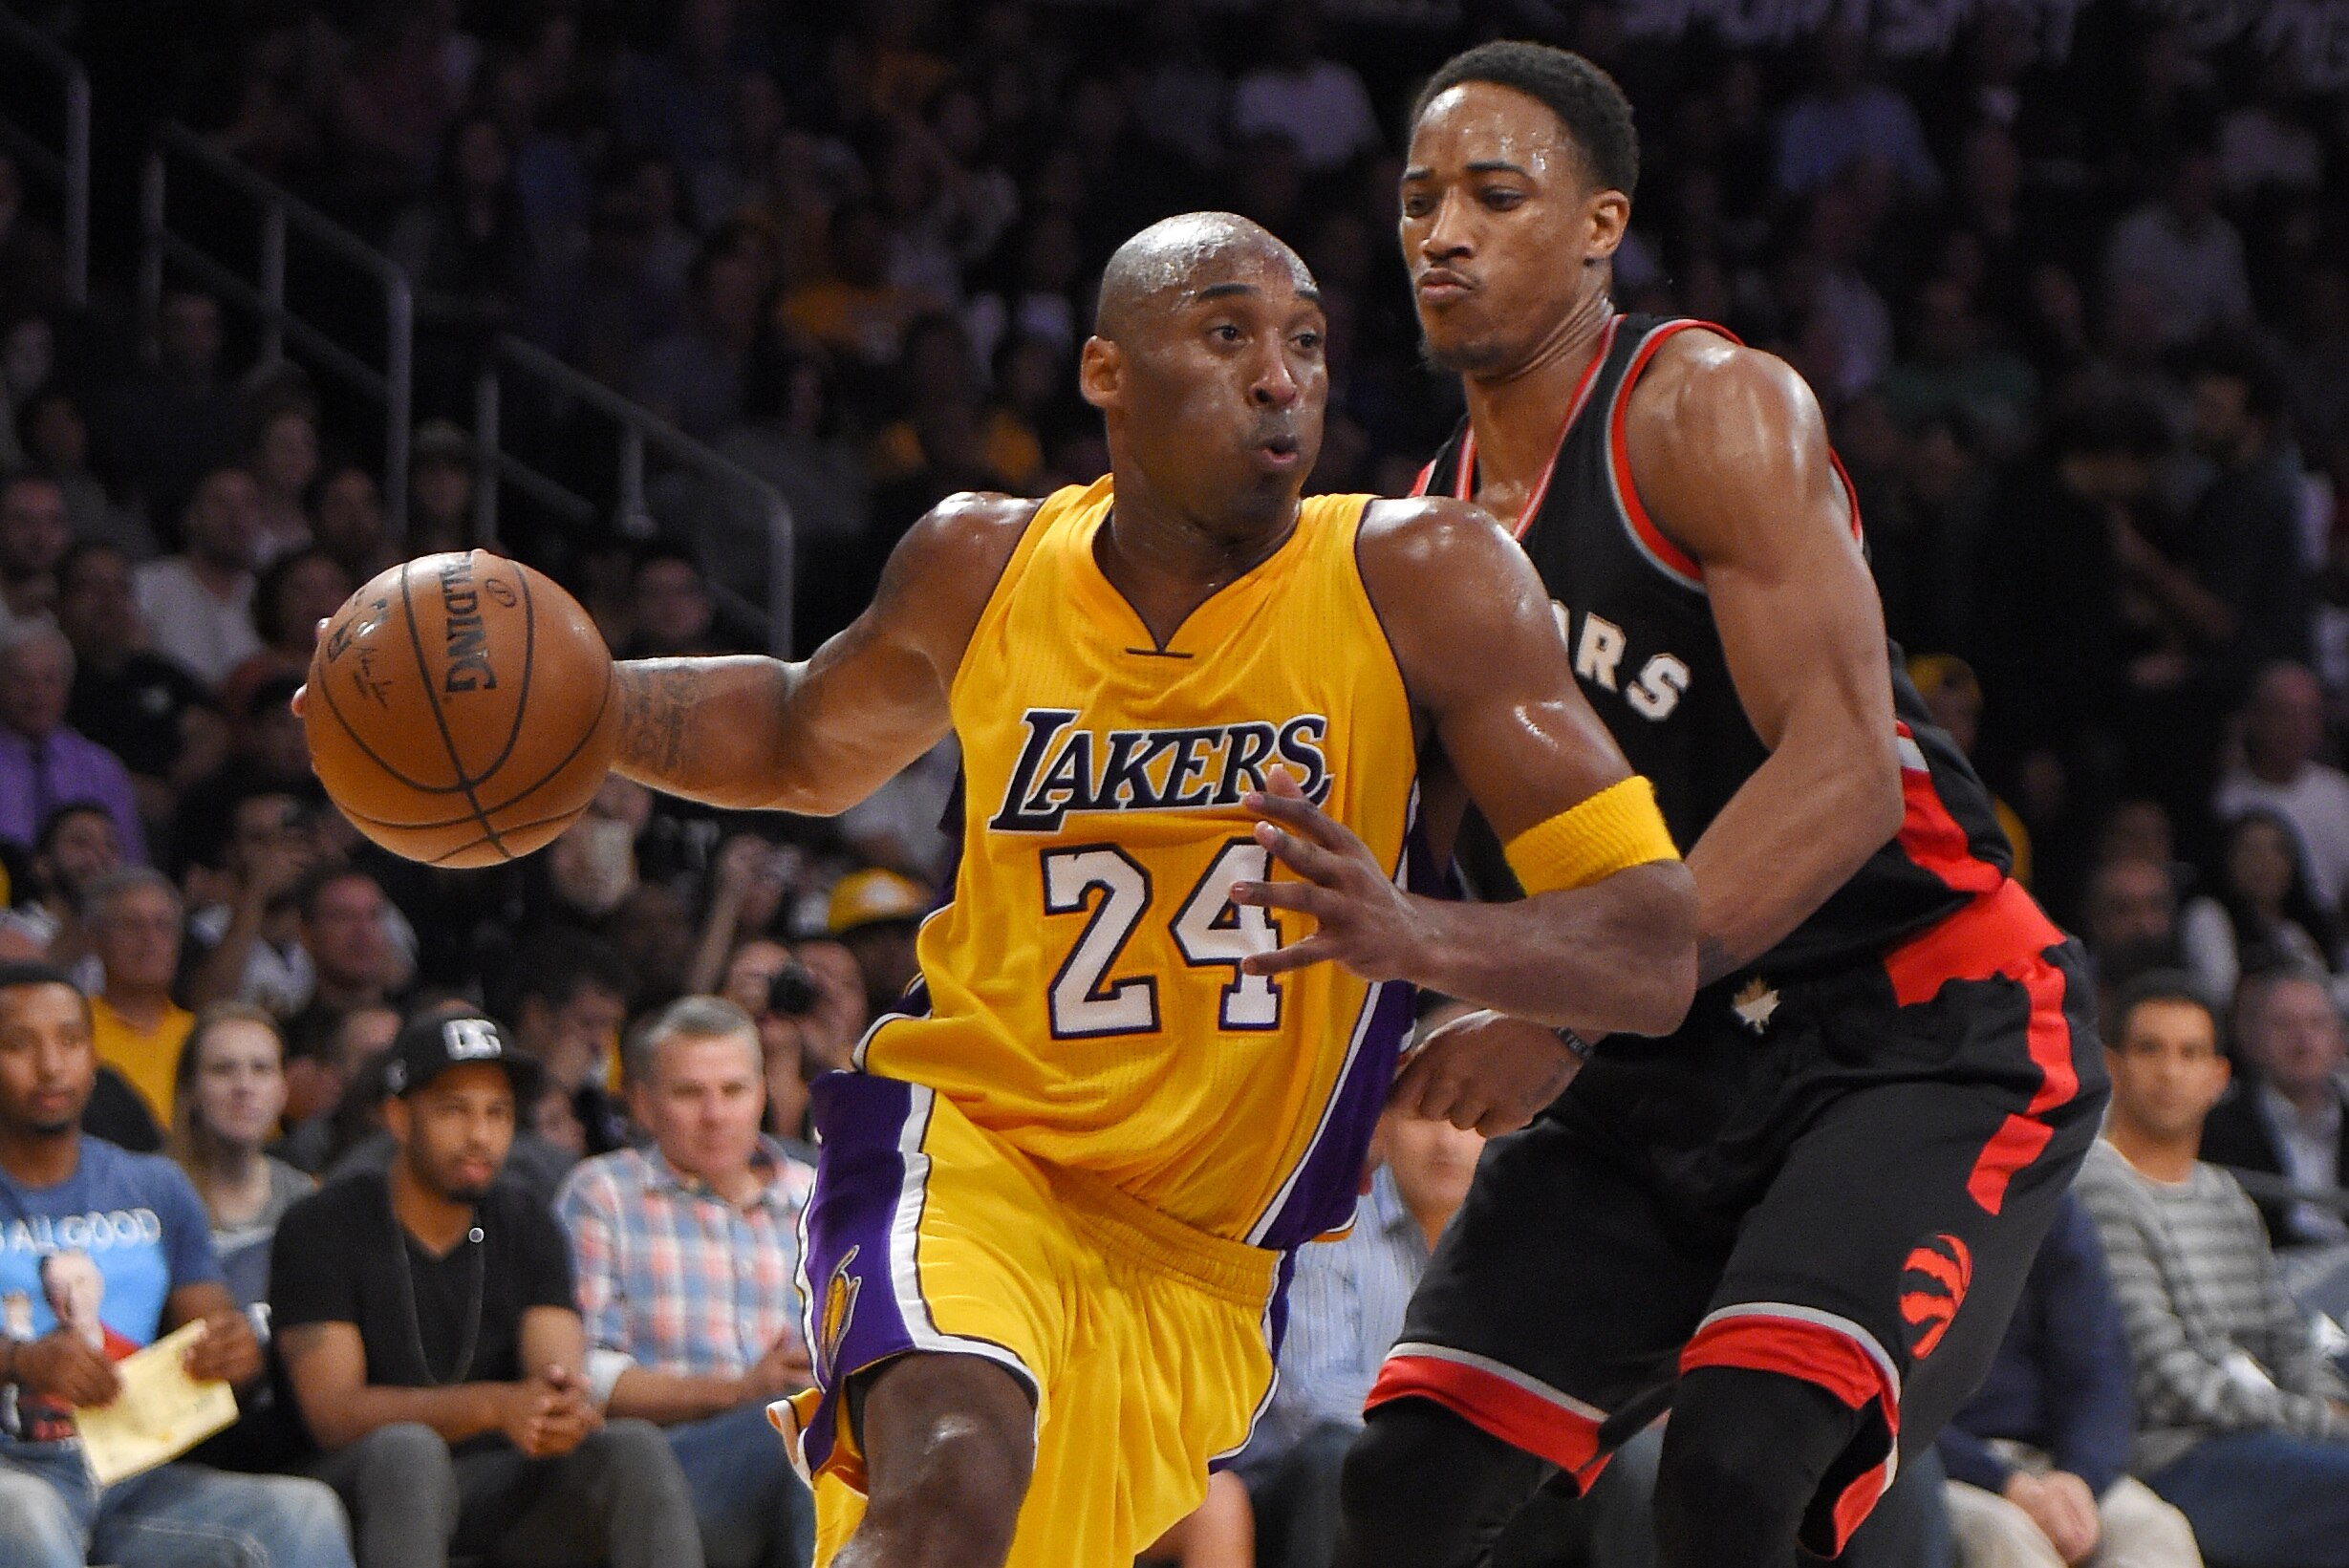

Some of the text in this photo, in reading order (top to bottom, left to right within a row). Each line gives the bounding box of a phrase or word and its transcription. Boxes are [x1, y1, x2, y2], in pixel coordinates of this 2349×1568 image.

[440, 552, 497, 693] ALDING
[1550, 598, 1692, 721] RS
[988, 707, 1335, 834] LAKERS
[1040, 835, 1282, 1041] 24
[56, 1207, 162, 1253] GOOD
